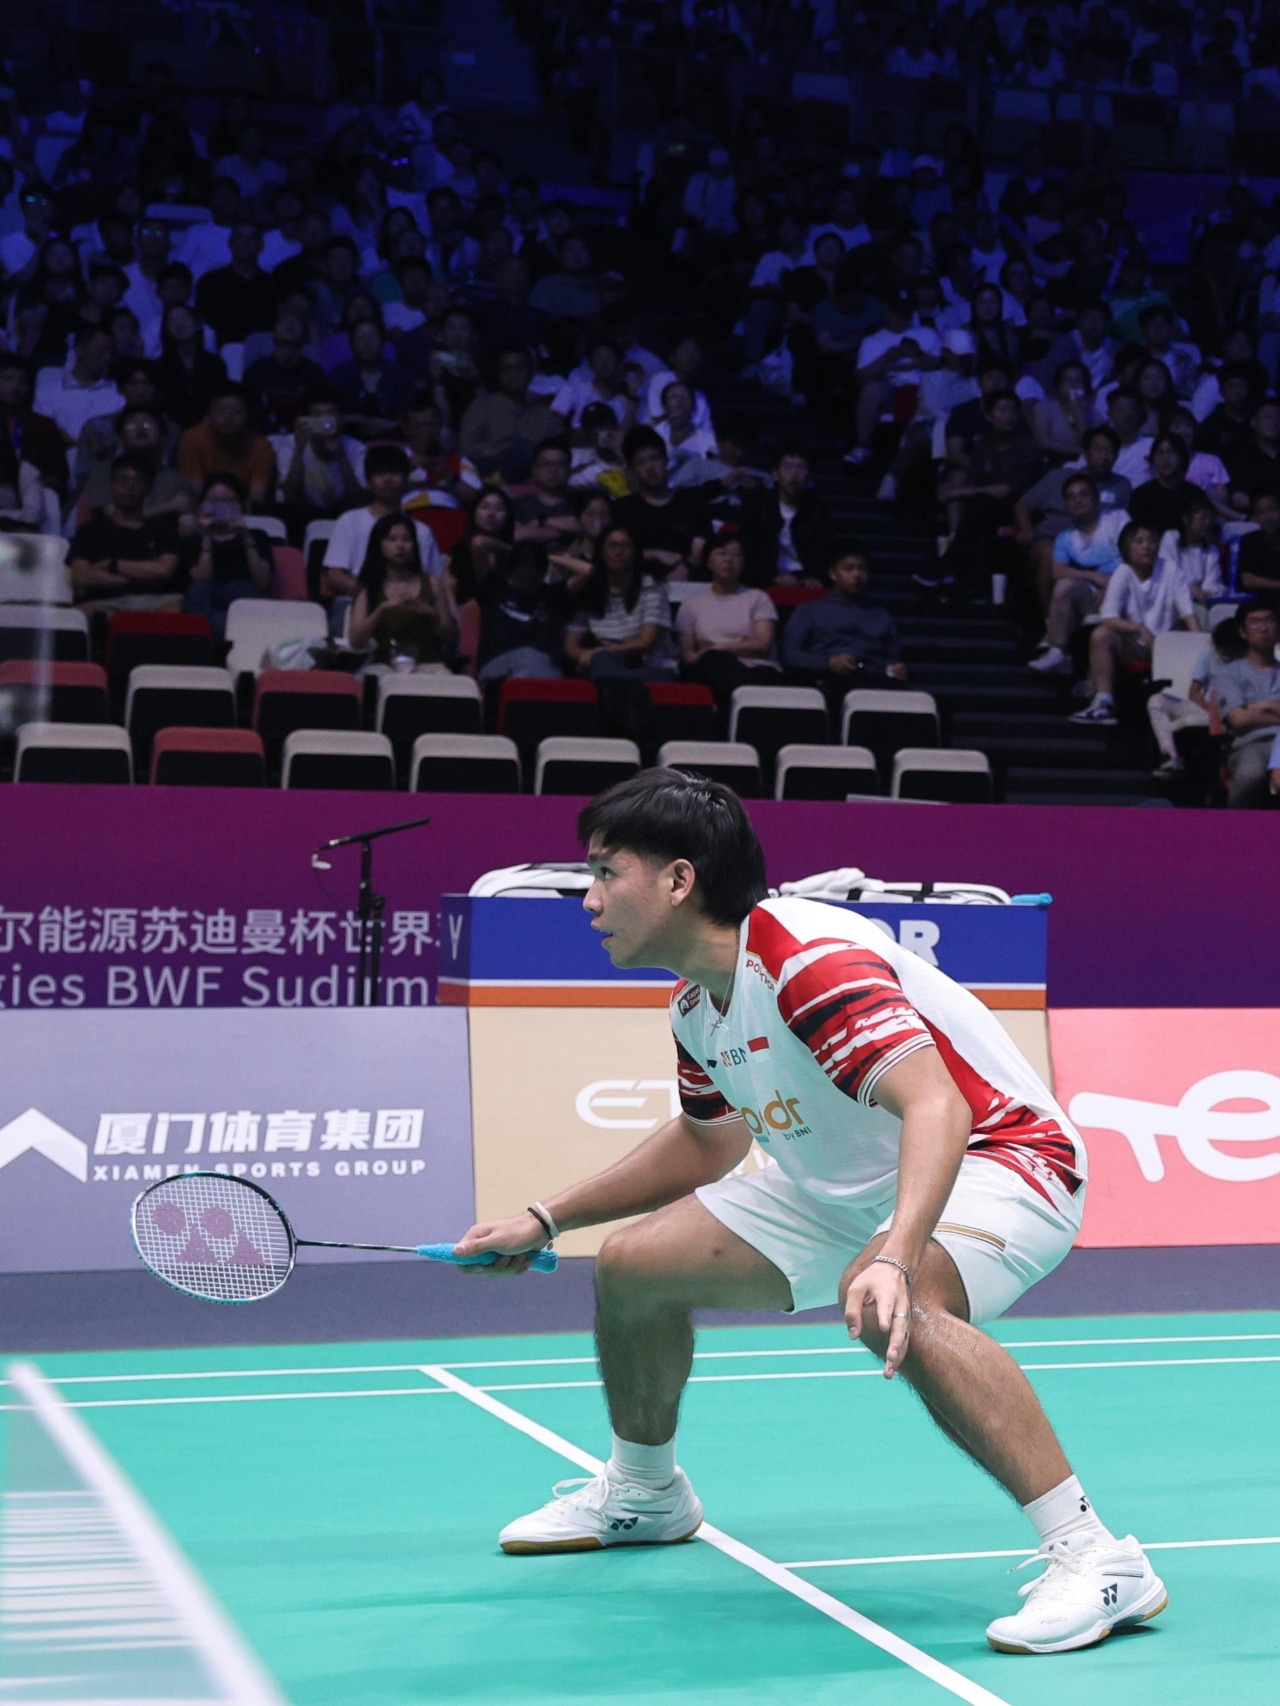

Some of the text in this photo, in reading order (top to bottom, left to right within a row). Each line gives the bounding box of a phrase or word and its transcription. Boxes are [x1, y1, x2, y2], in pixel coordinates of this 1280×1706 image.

[0, 963, 439, 1008] ies BWF Sudirm
[93, 1109, 424, 1155] 厦门体育集团
[794, 1126, 812, 1138] BNI
[94, 1159, 426, 1181] XIAMEN SPORTS GROUP
